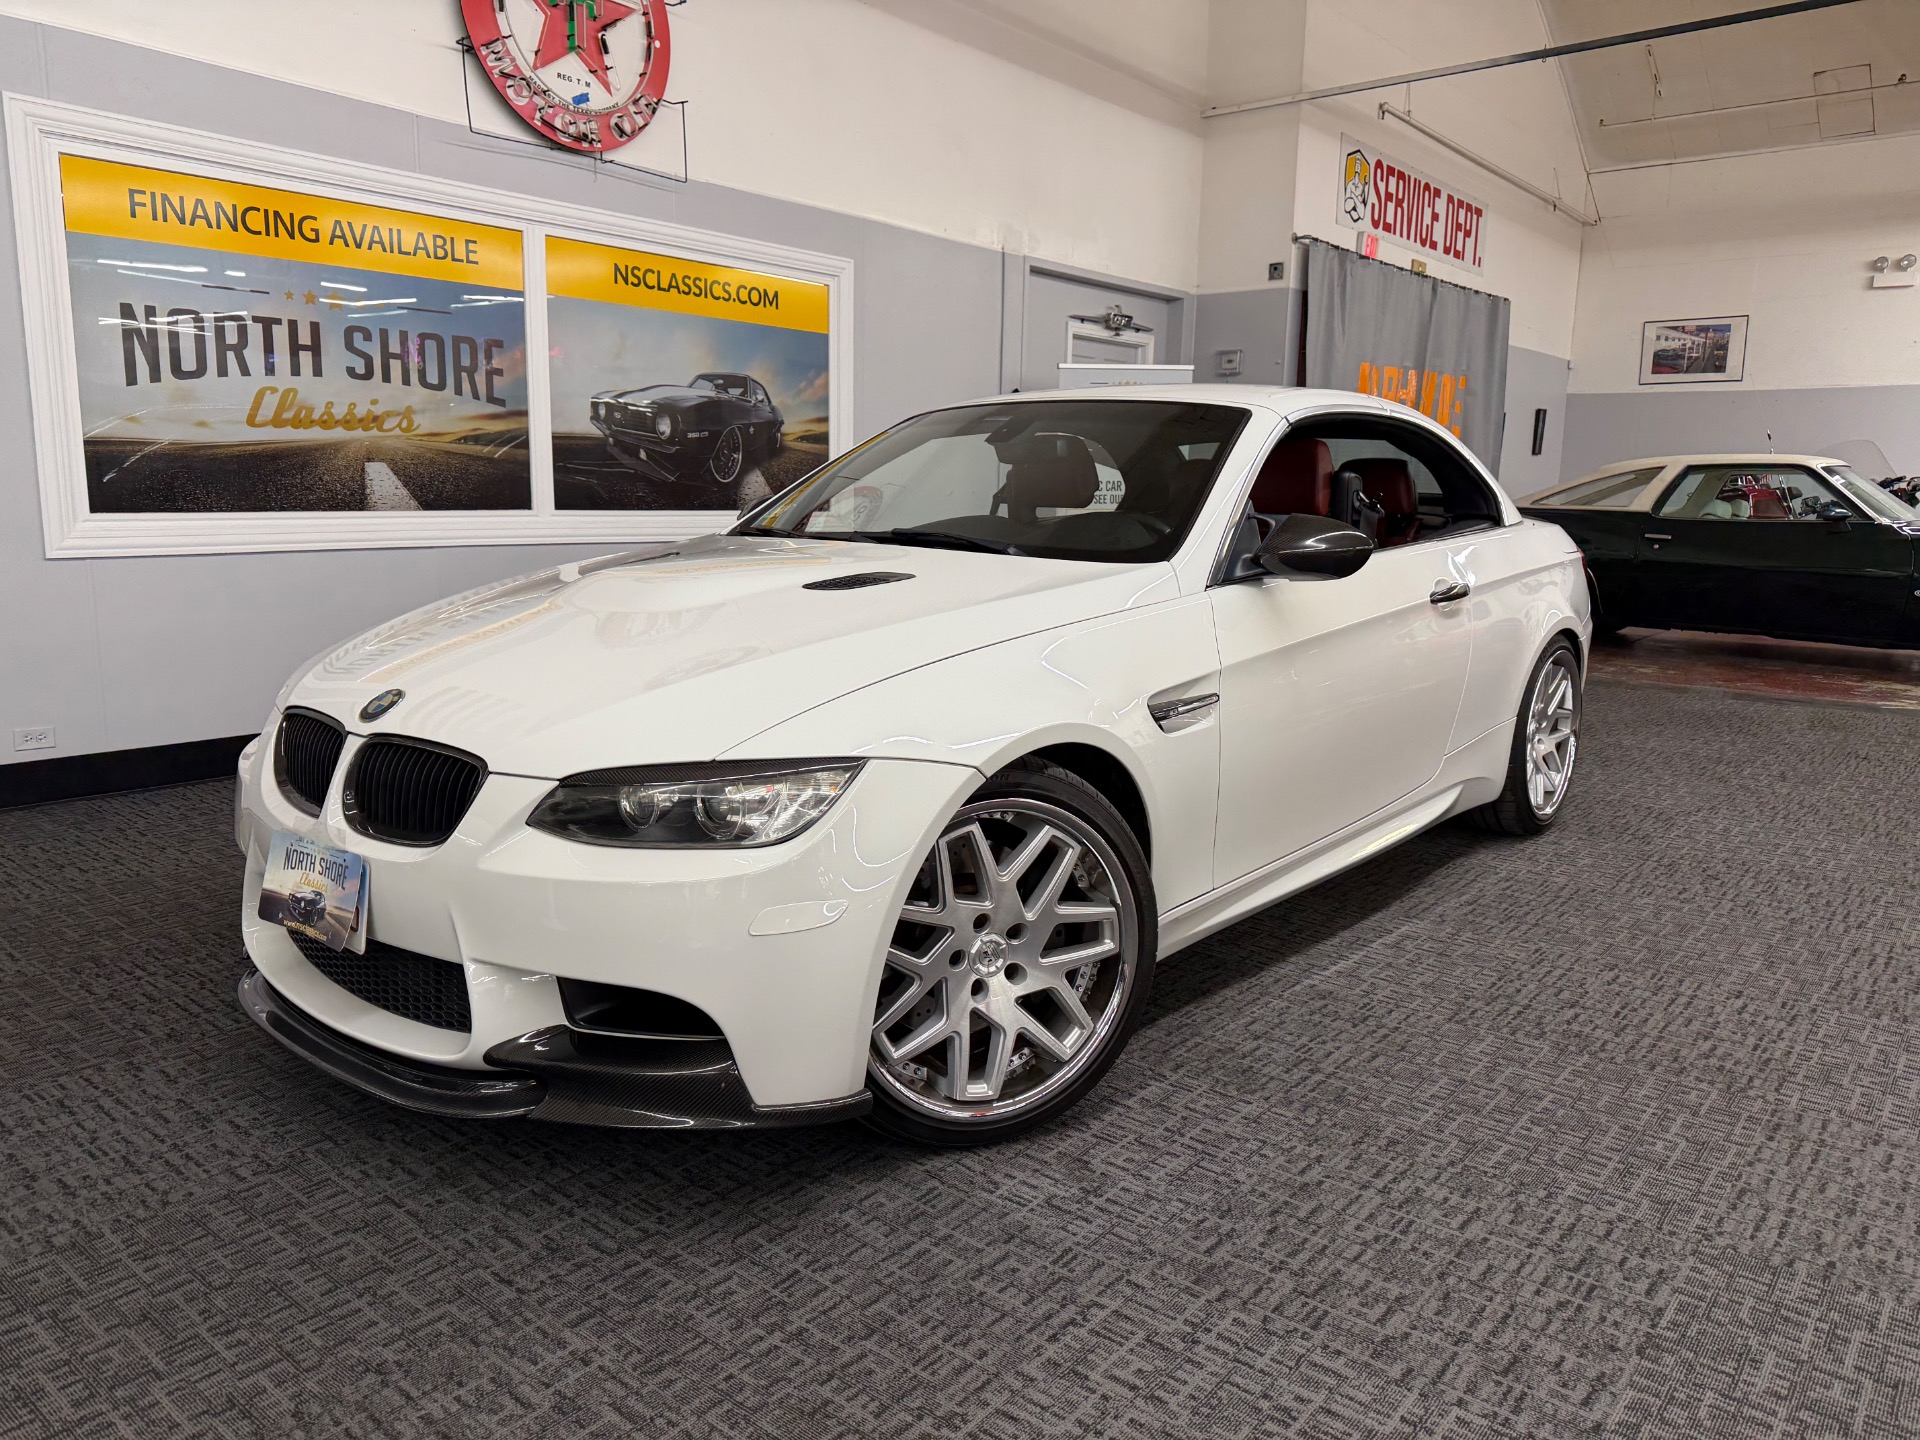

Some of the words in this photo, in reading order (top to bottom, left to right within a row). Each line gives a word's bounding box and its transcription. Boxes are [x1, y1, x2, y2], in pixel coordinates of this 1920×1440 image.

[480, 38, 602, 147] MOTOR
[547, 93, 556, 101] BY
[558, 100, 570, 109] THE
[557, 72, 575, 84] REG.
[128, 188, 320, 244] FINANCING
[329, 219, 479, 265] AVAILABLE
[1371, 159, 1441, 251] SERVICE
[1443, 193, 1483, 268] DEPT.
[613, 262, 779, 310] NSCLASSICS.COM
[119, 302, 323, 387] NORTH
[344, 325, 507, 408] SHORE
[246, 386, 421, 434] Classics
[1094, 494, 1107, 504] SEE
[1105, 480, 1122, 491] CAR
[283, 846, 317, 873] NORTH
[318, 857, 349, 891] SHORE
[299, 872, 329, 894] Classics
